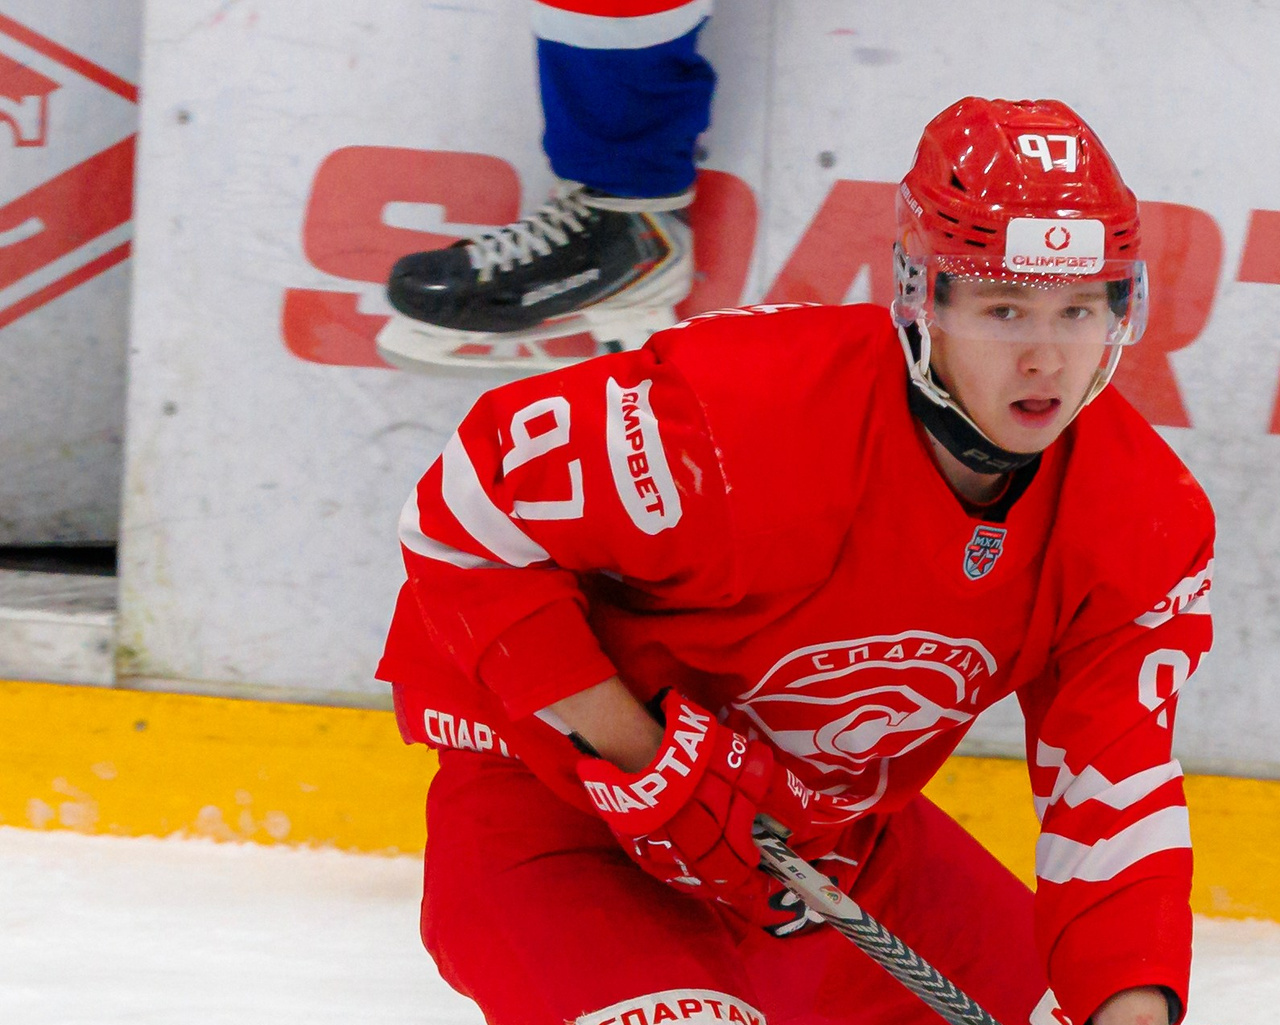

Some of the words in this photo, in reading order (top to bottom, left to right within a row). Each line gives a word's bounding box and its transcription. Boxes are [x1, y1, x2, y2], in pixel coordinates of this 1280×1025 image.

[1017, 133, 1077, 173] 97
[1012, 255, 1099, 268] OLIMPBET
[502, 395, 585, 521] 97
[974, 536, 1002, 549] МХЛ
[811, 642, 984, 682] СПАРТАК
[583, 703, 711, 814] СПАРТАК
